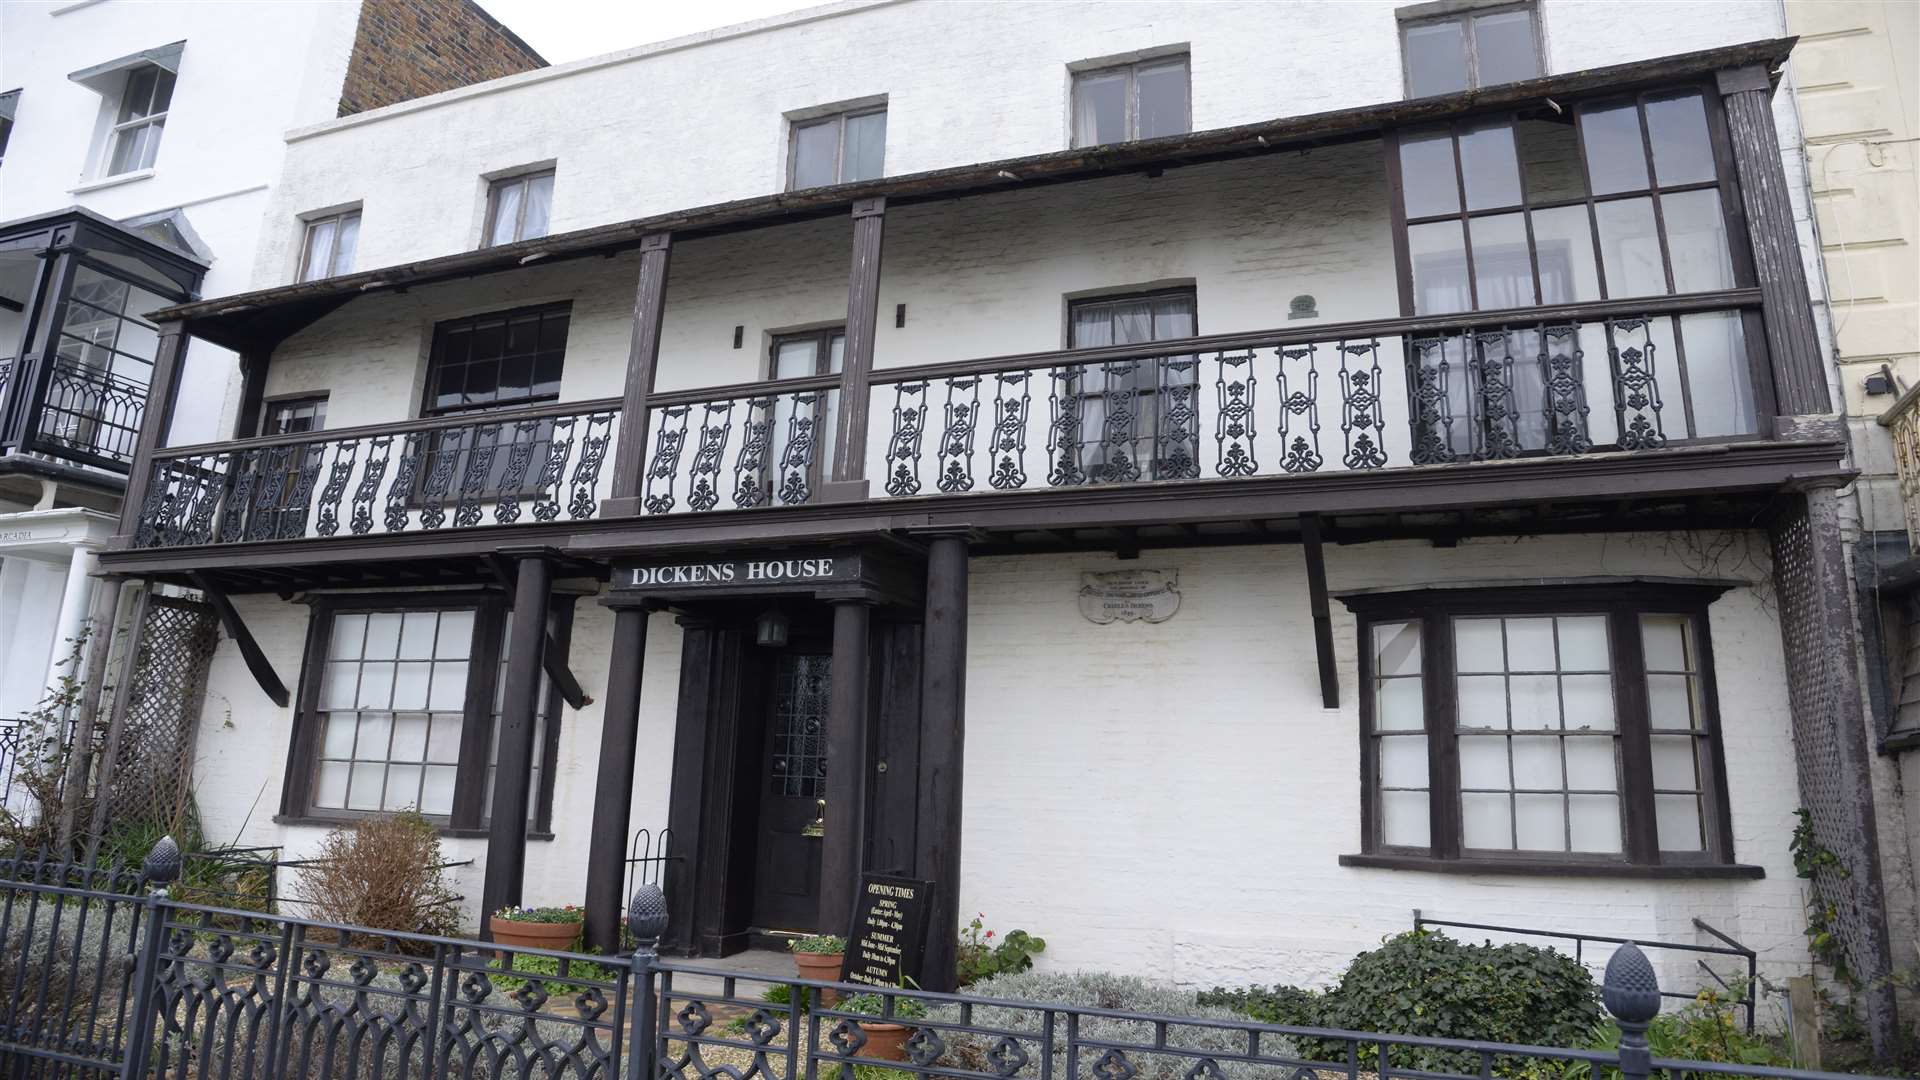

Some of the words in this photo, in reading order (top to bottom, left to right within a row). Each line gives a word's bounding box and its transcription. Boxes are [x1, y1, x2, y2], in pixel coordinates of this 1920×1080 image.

[632, 563, 735, 585] DICKENS
[746, 558, 834, 580] HOUSE
[868, 883, 895, 897] OPENING
[894, 886, 914, 899] TIMES
[879, 899, 897, 909] SPRING
[870, 931, 894, 943] SUMMER
[865, 965, 888, 977] AUTUMN
